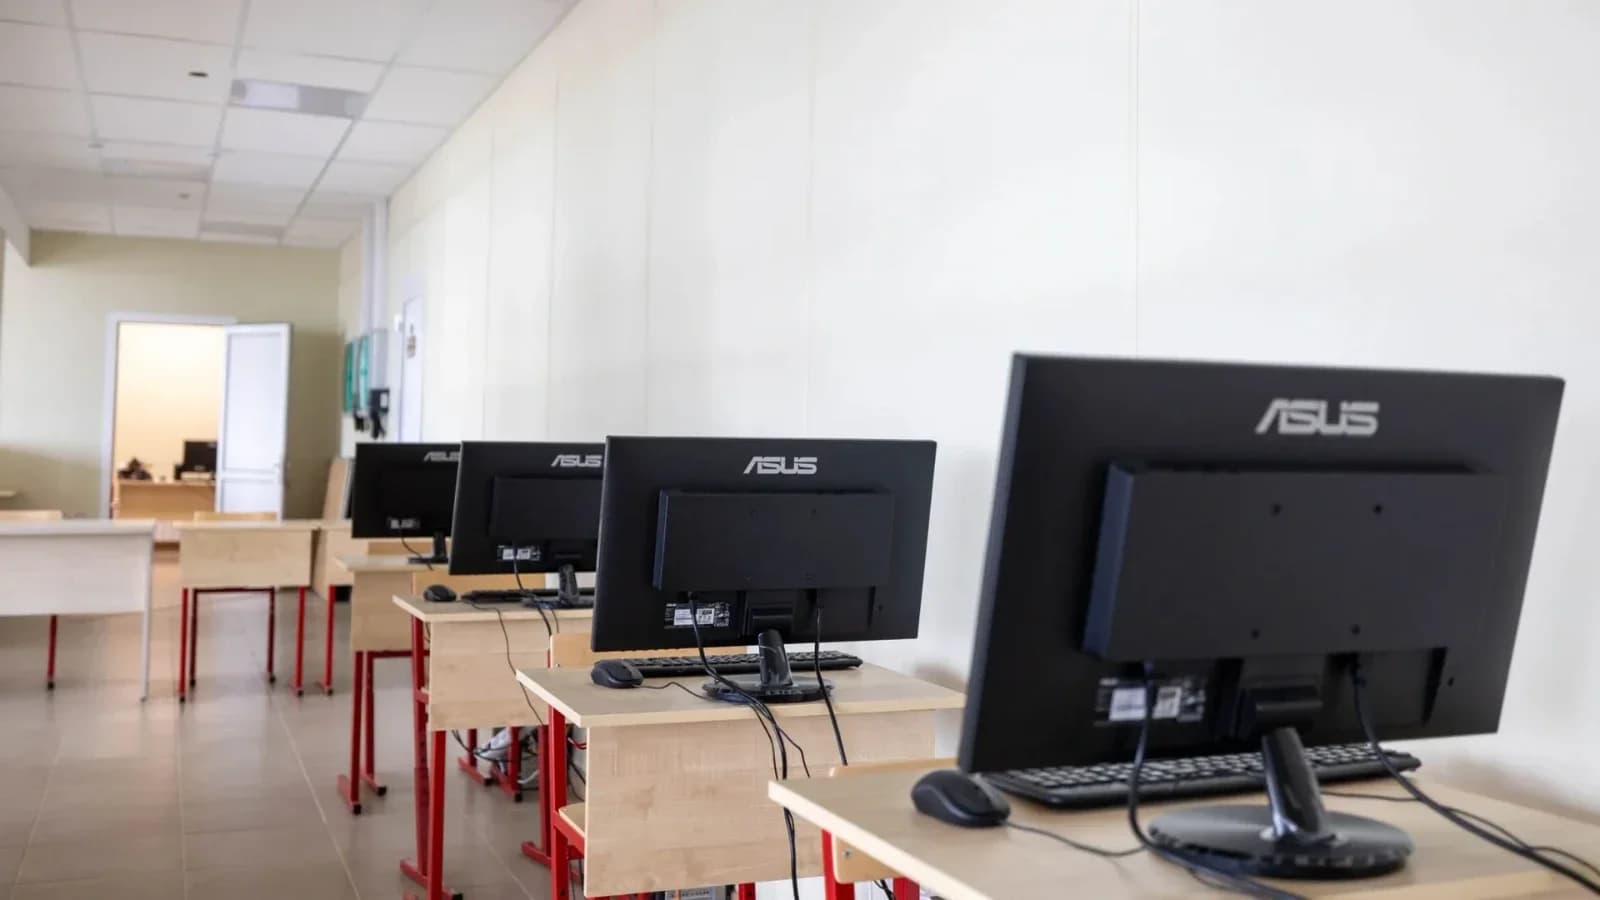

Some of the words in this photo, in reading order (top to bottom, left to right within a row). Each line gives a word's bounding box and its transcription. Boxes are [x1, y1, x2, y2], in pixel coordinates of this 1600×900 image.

[1255, 398, 1380, 436] ASUS
[423, 451, 460, 462] ASUS
[551, 454, 603, 468] ASUS
[743, 456, 818, 475] ASUS
